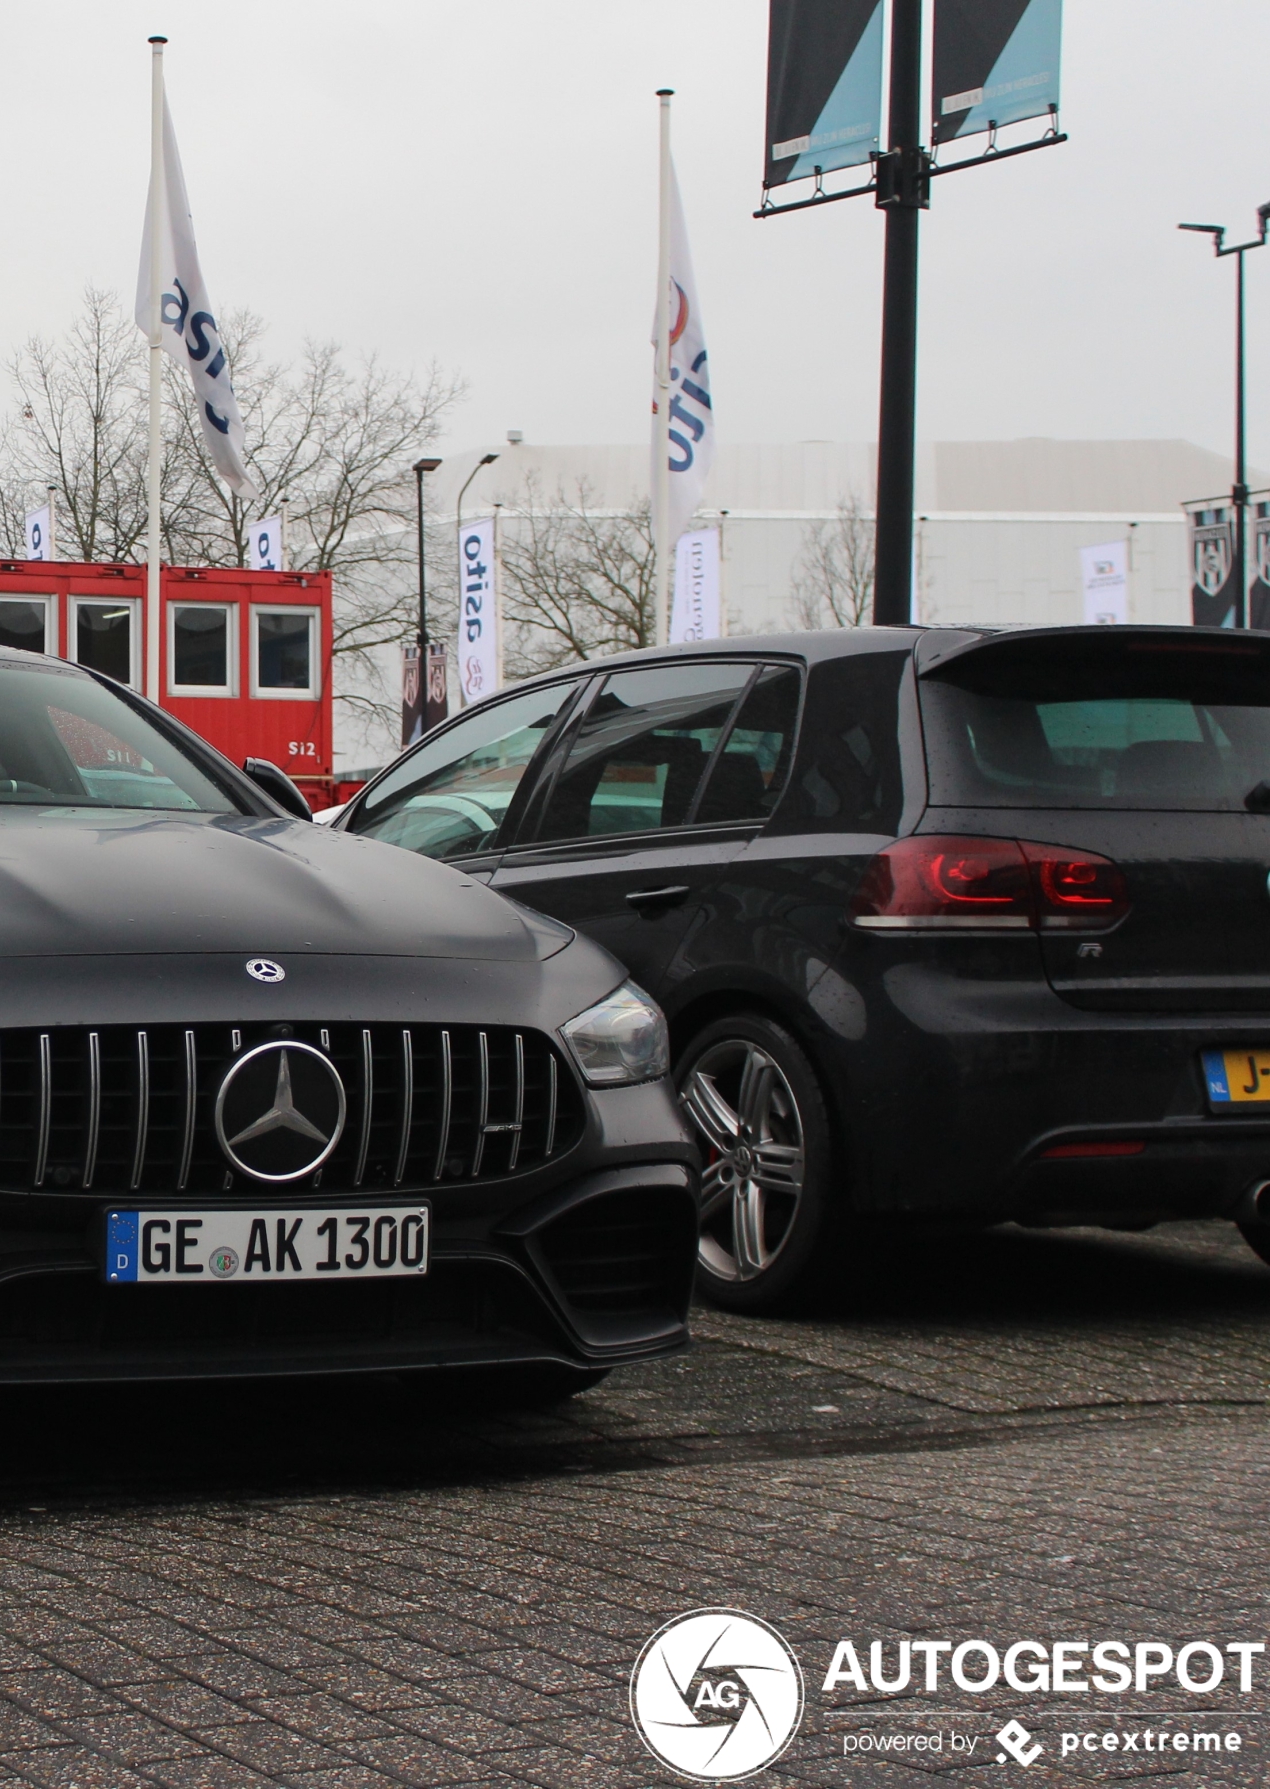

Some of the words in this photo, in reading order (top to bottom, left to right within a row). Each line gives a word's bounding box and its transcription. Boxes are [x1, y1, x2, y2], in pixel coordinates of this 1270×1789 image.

[1078, 943, 1102, 957] R
[1211, 1081, 1227, 1094] NL
[142, 1219, 204, 1274] GE
[243, 1217, 303, 1272] AK
[316, 1214, 425, 1271] 1300
[117, 1254, 129, 1270] D
